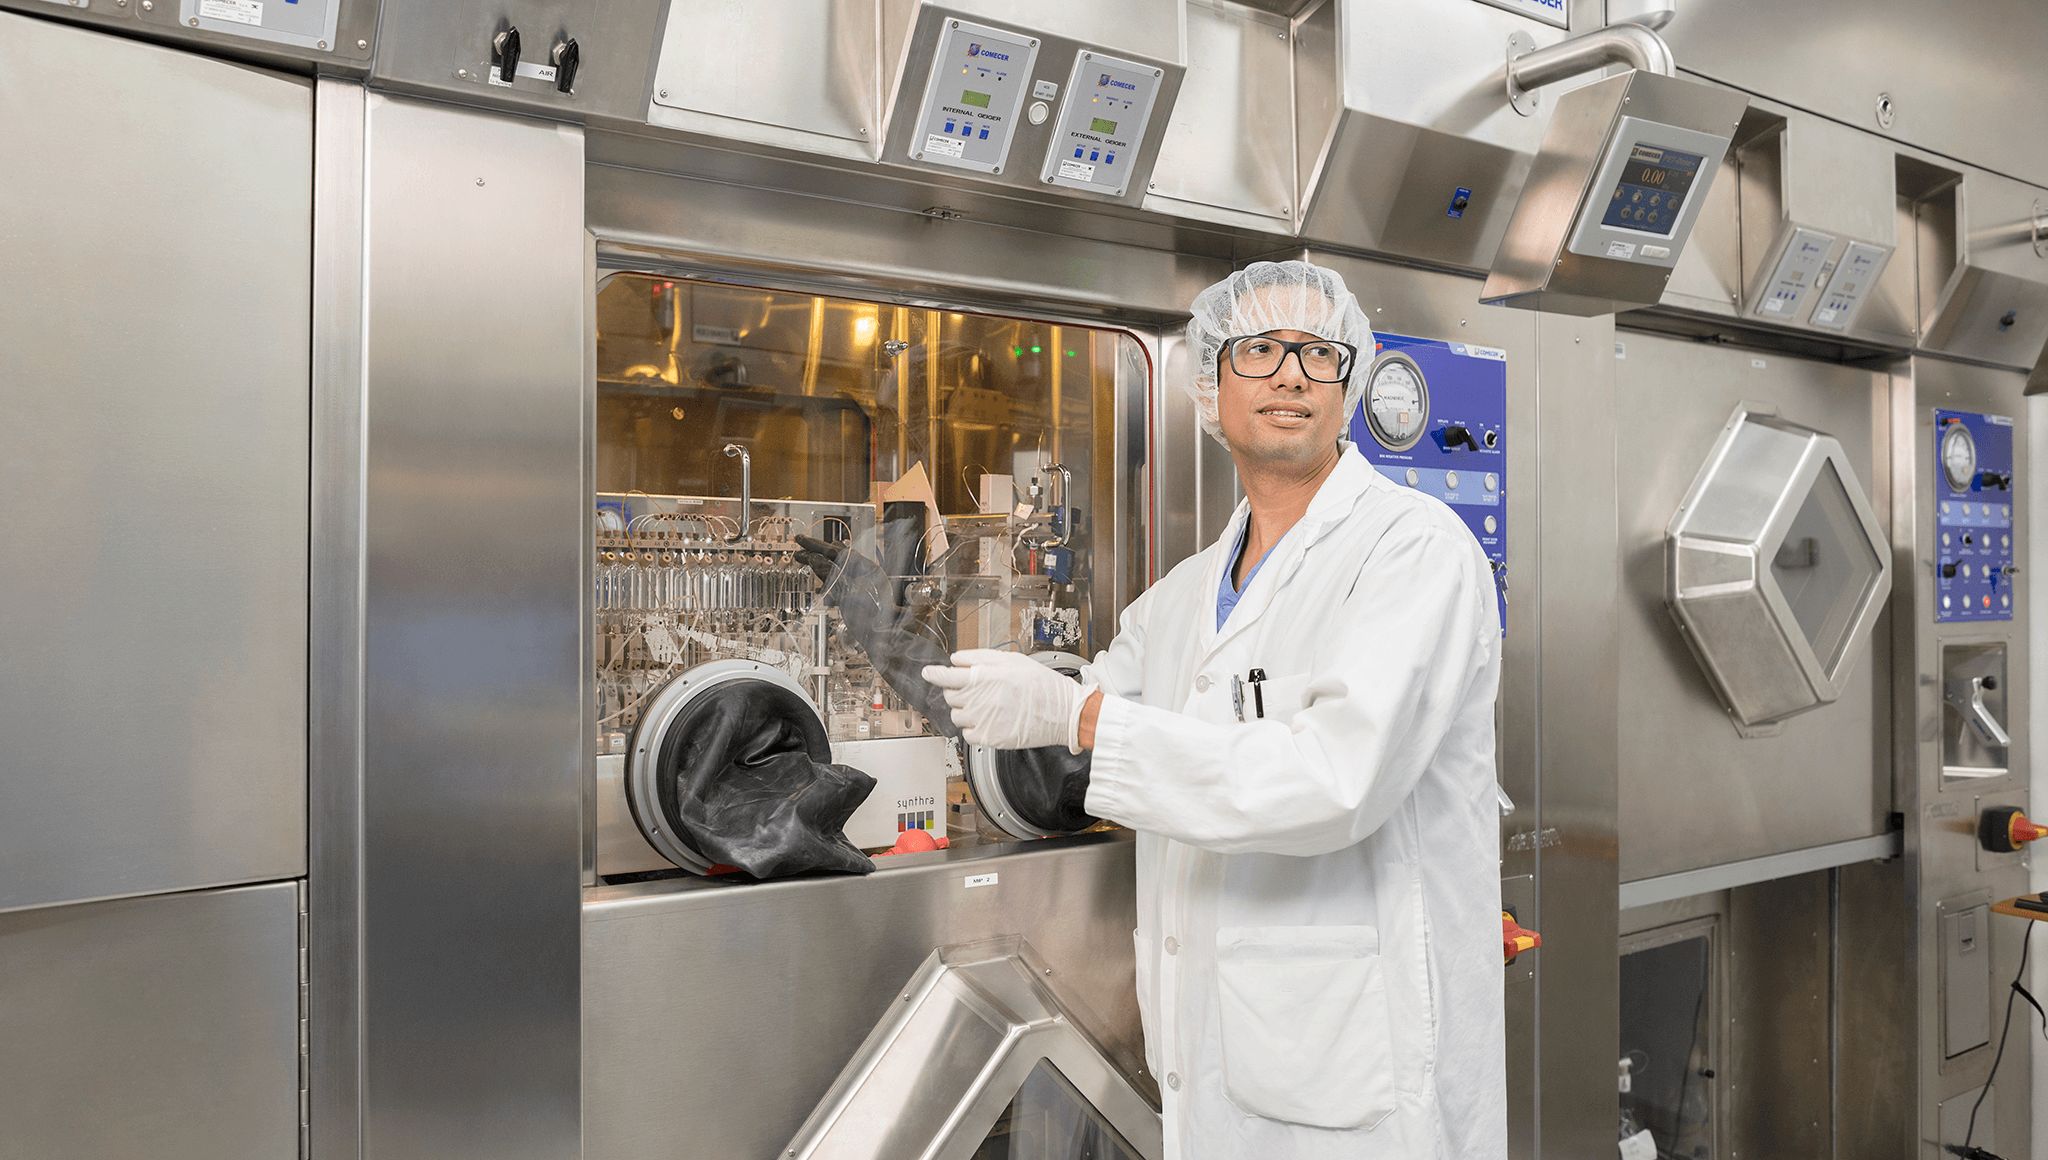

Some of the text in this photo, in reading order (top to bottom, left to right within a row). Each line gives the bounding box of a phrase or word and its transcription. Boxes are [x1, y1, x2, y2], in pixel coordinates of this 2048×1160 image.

[981, 49, 1010, 61] COMECER
[538, 69, 554, 77] AIR
[1110, 80, 1136, 90] COMECER
[942, 106, 1002, 122] INTERNAL GEIGER
[1071, 132, 1127, 147] EXTERNAL GEIGER
[1638, 150, 1661, 160] COMECER
[1641, 168, 1666, 185] 0.00
[897, 796, 935, 809] synthra
